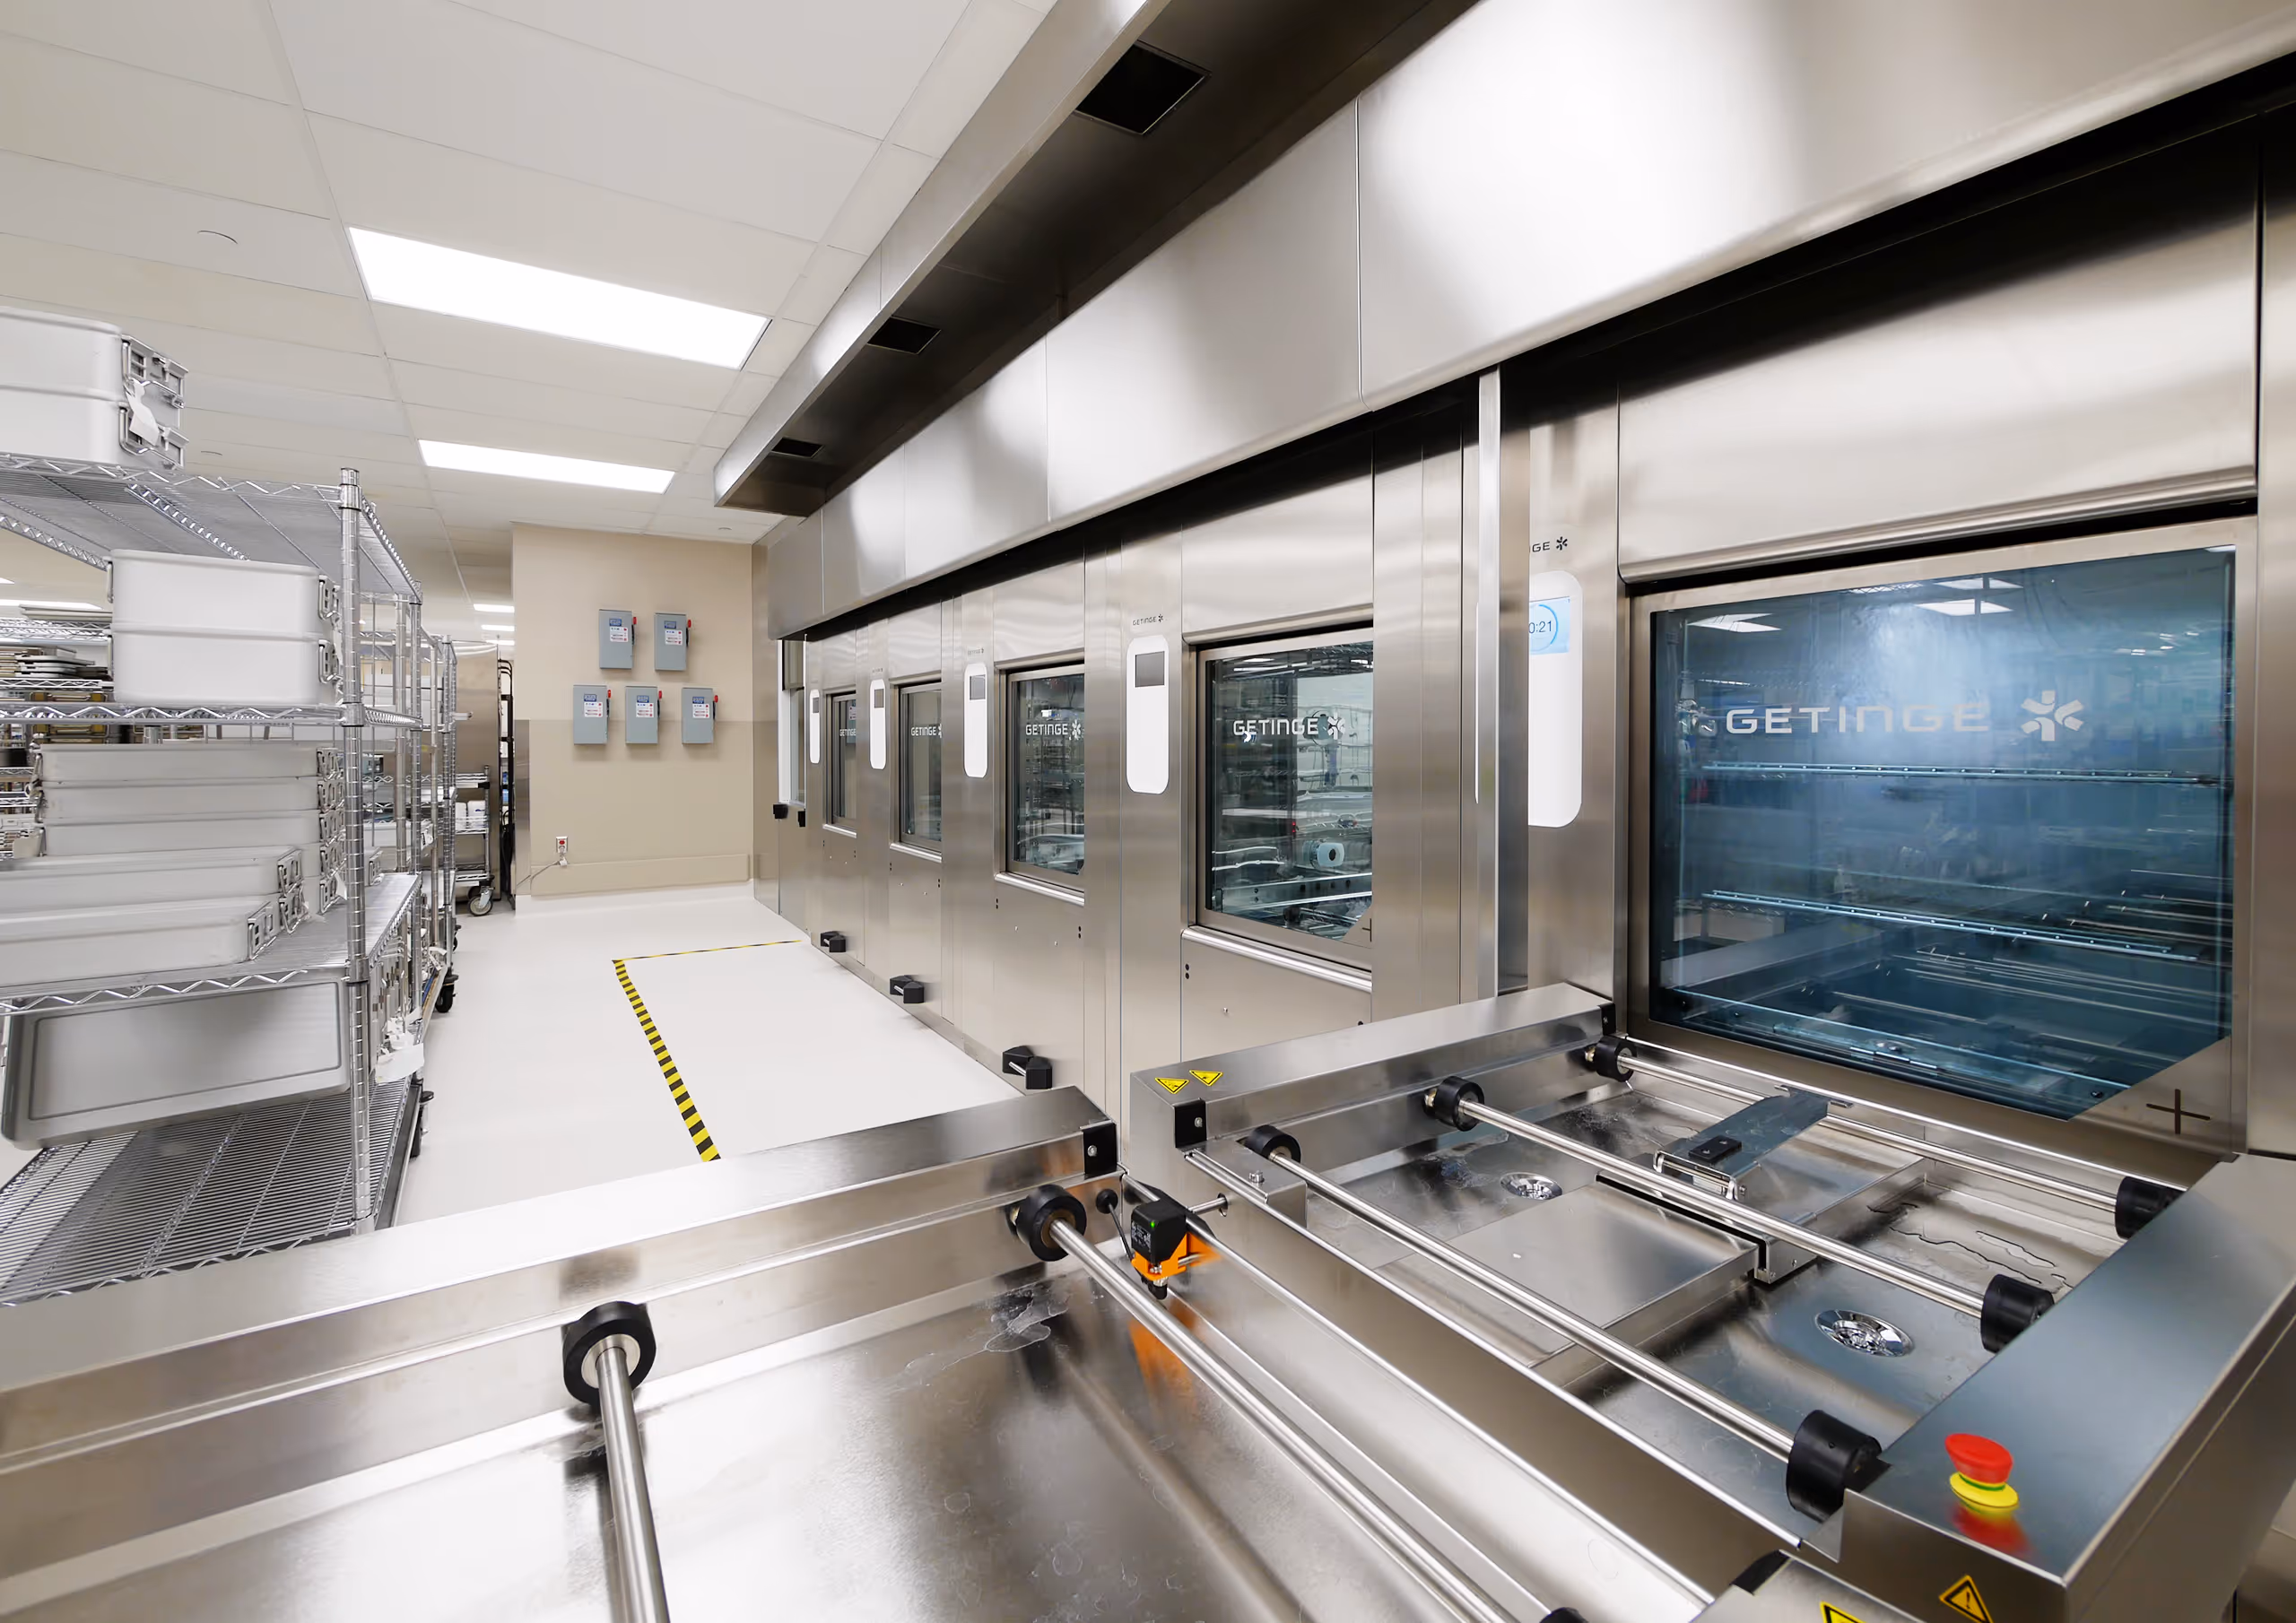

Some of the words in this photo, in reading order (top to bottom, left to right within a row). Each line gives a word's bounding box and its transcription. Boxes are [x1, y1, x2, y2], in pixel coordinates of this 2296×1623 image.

[1132, 615, 1157, 626] GETINGE
[1726, 703, 1989, 734] GETINGE
[910, 726, 937, 736] GETINGE
[1025, 723, 1069, 735] GETINGE
[1233, 718, 1319, 735] GETINGE
